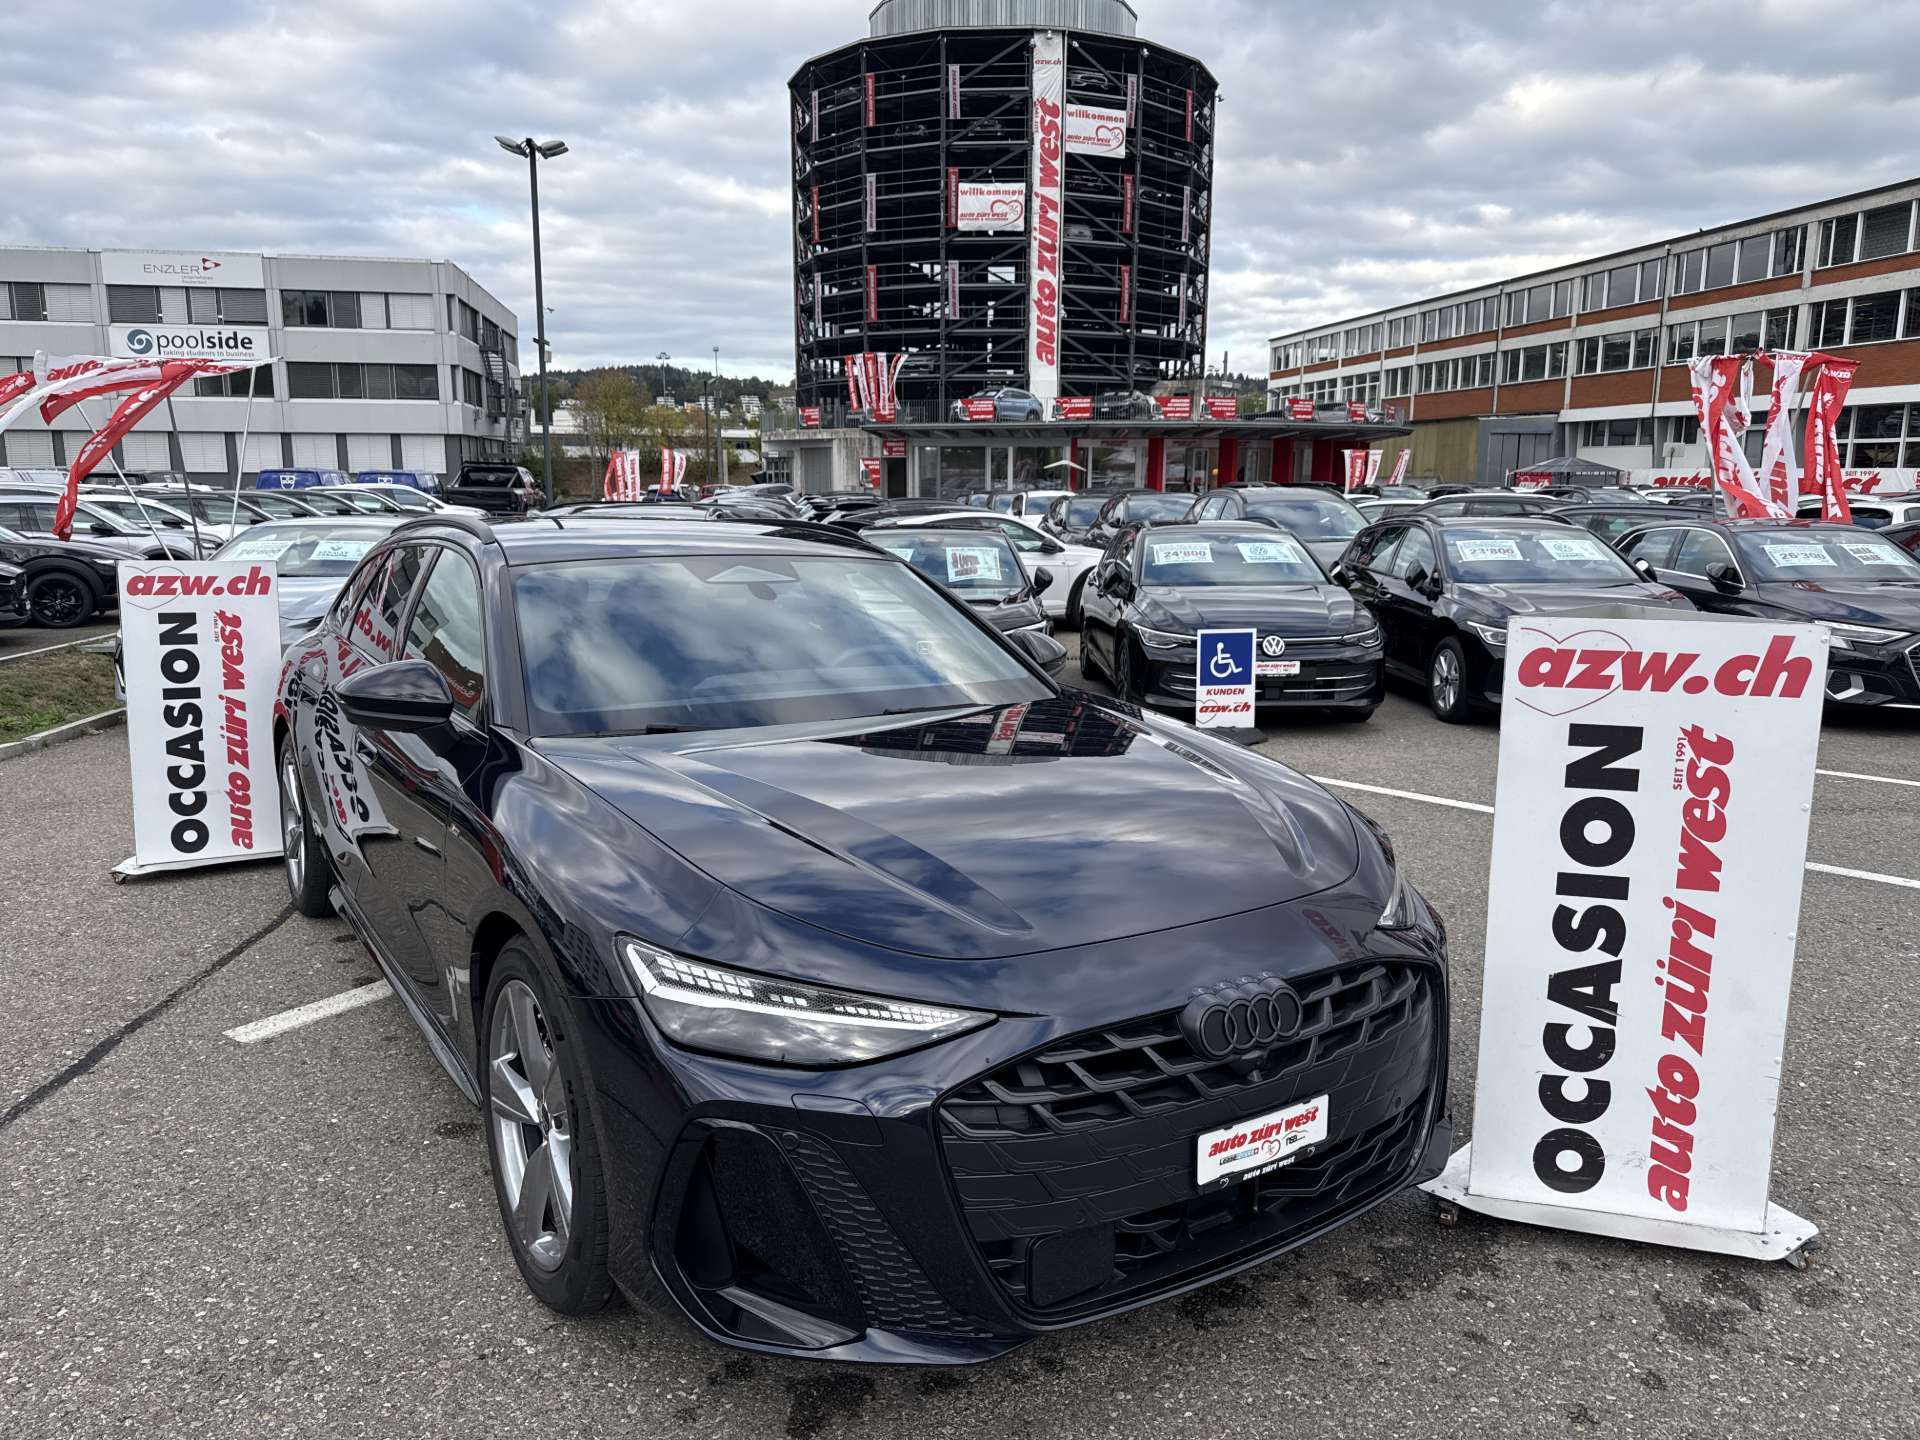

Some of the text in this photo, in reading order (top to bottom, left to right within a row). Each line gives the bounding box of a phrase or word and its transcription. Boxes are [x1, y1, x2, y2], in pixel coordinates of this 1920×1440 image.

[1067, 109, 1124, 124] willkommen
[960, 187, 1023, 196] willkommen
[1032, 95, 1060, 367] auto züri west
[143, 263, 200, 274] ENZLER
[156, 330, 253, 355] poolside
[225, 350, 255, 358] business
[1779, 552, 1826, 561] 26'300
[126, 566, 272, 597] azw.ch
[1517, 635, 1813, 699] azw.ch
[1206, 687, 1246, 696] KUNDEN
[1199, 701, 1252, 713] azw.ch
[158, 612, 210, 854] OCCASION
[213, 609, 254, 850] auto züri west
[1672, 736, 1688, 791] SEIT 1991
[1532, 722, 1645, 1194] OCCASION
[1644, 723, 1736, 1213] auto züri west
[1208, 1131, 1248, 1158] auto
[1247, 1117, 1284, 1144] züri
[1284, 1105, 1319, 1132] west
[1242, 1156, 1296, 1181] auto züri west
